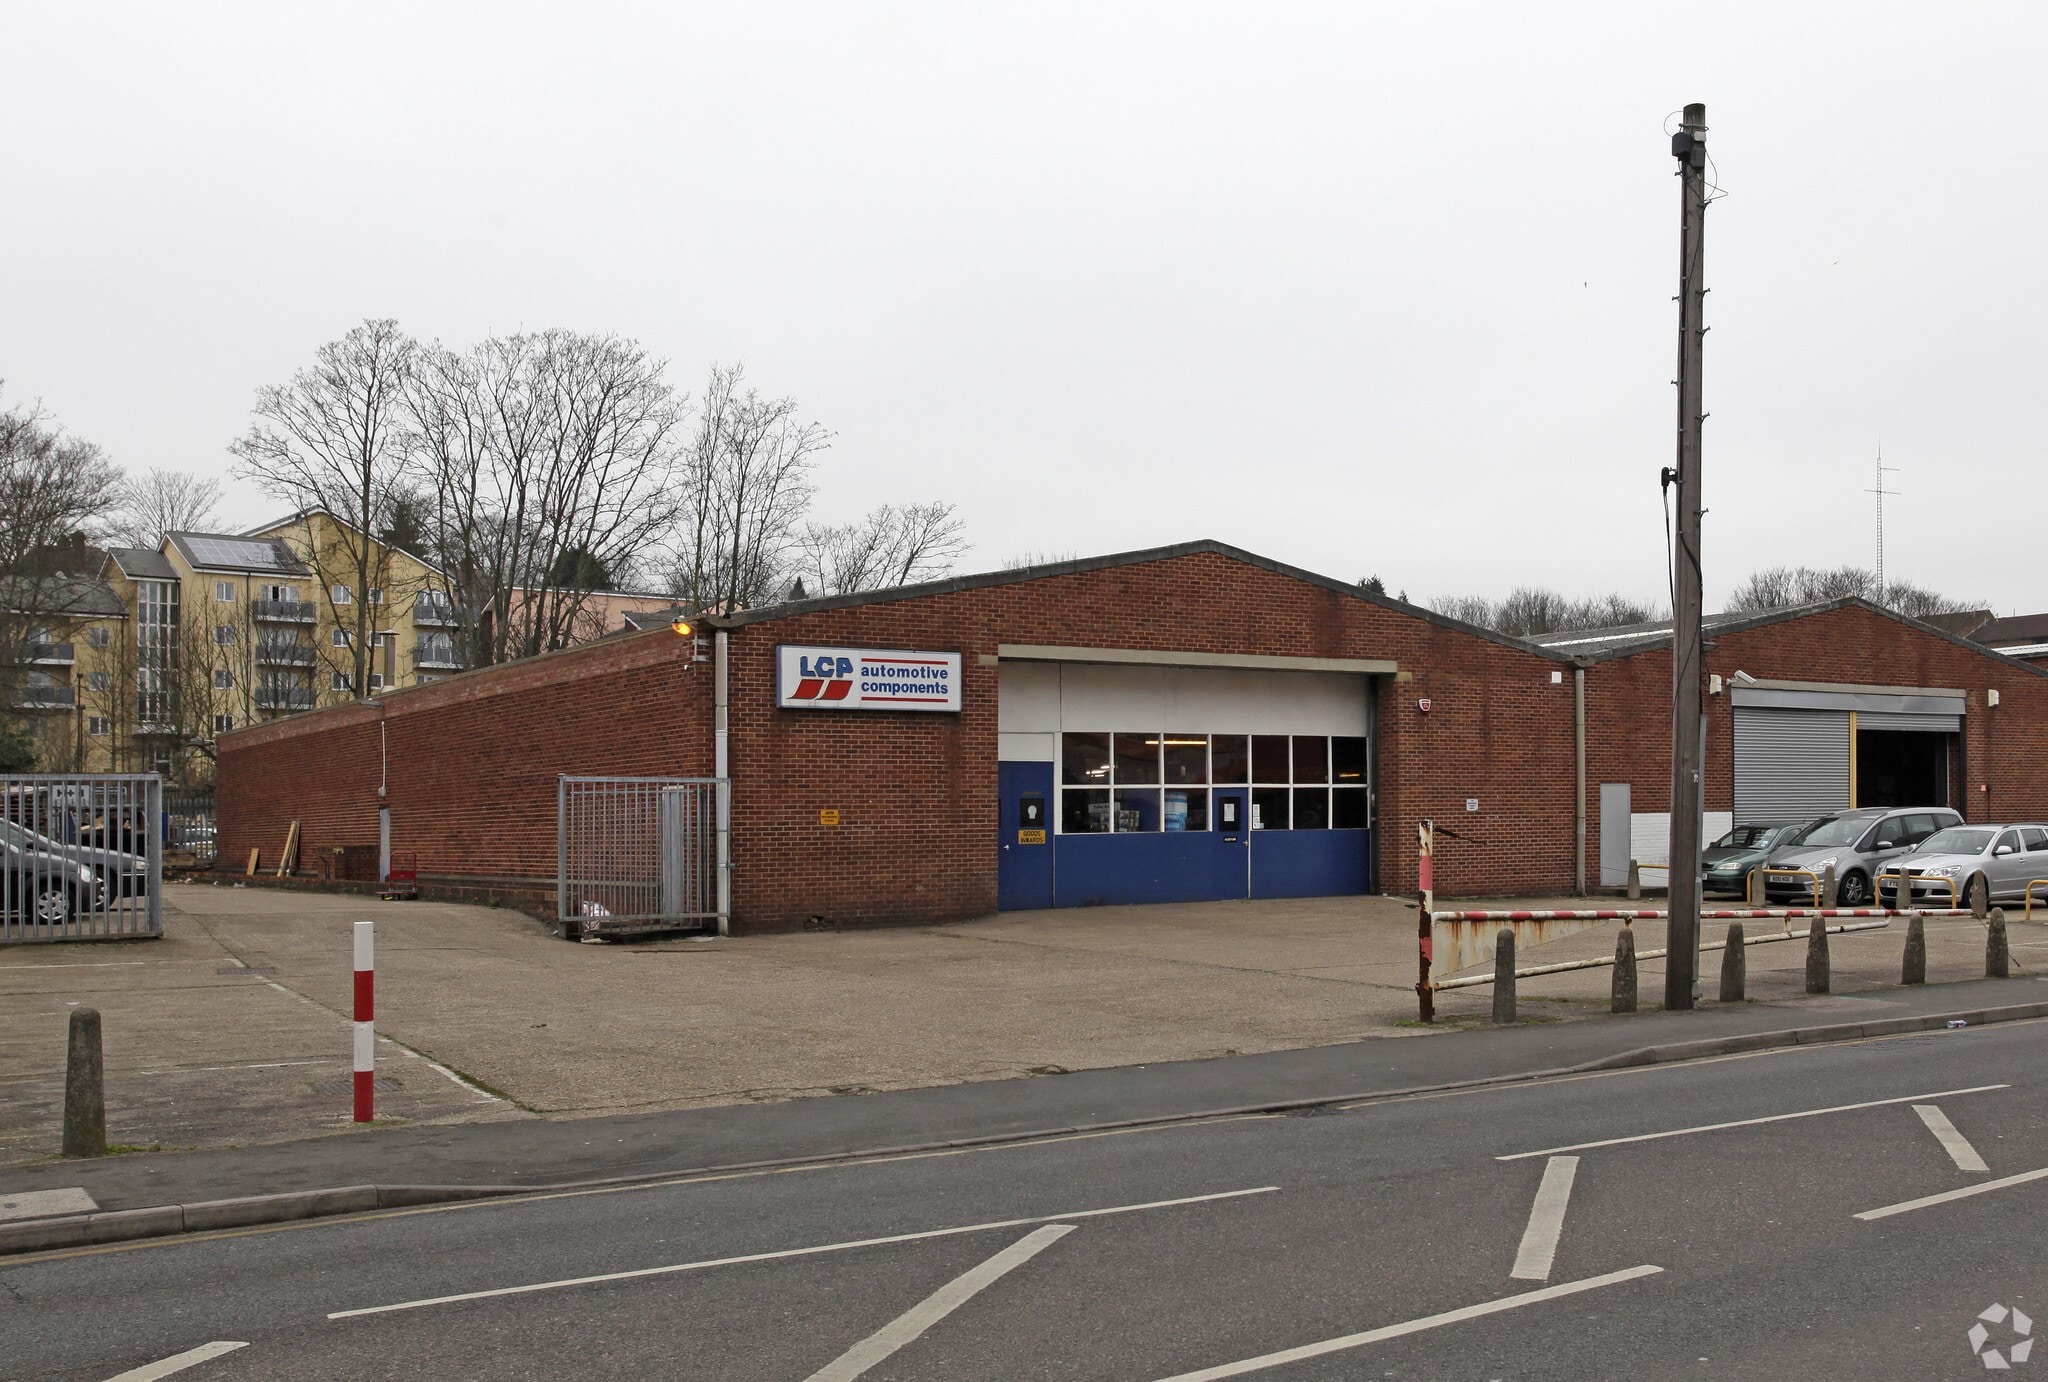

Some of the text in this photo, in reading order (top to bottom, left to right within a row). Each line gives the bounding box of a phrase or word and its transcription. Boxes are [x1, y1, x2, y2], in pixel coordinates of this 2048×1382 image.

[800, 655, 854, 678] LCP
[861, 665, 948, 679] automotive
[861, 681, 948, 696] components
